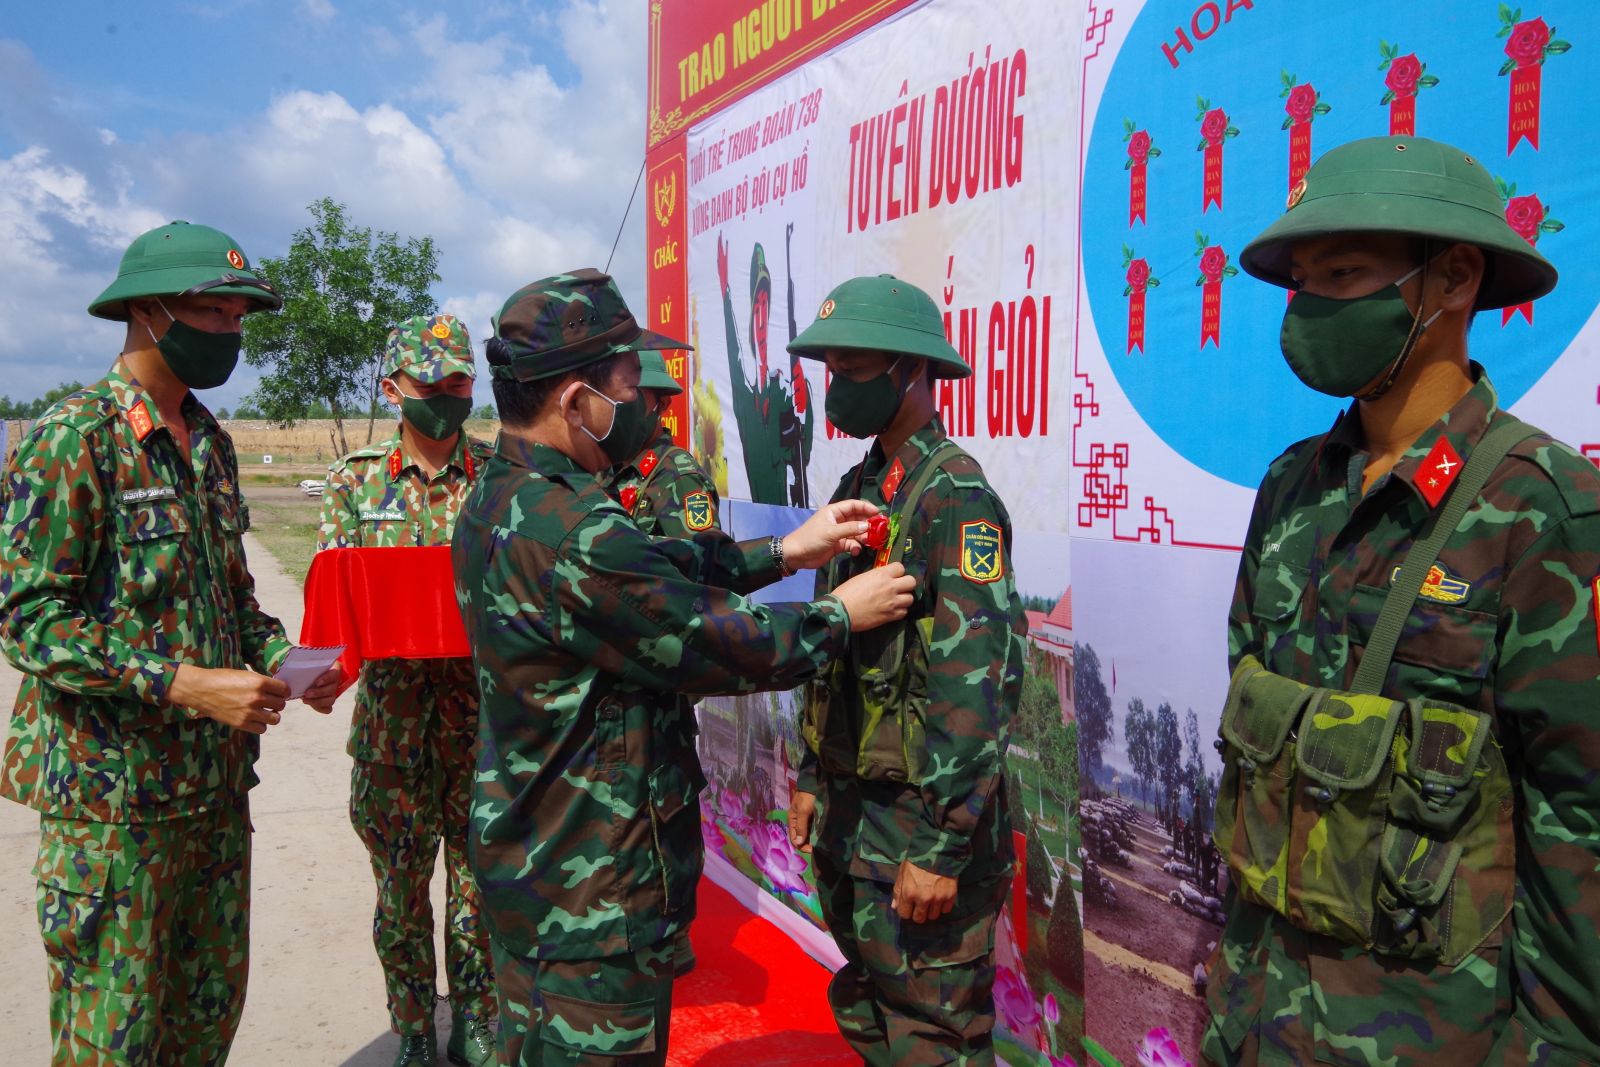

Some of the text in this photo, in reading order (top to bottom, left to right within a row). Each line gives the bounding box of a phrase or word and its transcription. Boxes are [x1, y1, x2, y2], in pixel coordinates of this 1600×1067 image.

[678, 32, 726, 102] TRAO
[1514, 81, 1536, 96] HOA
[690, 138, 706, 187] TUỔI
[708, 128, 725, 175] TRẺ
[727, 120, 760, 165] TRUNG
[797, 88, 823, 131] 738
[847, 44, 1027, 234] TUYÊN DƯƠNG
[711, 187, 733, 228] DANH
[735, 174, 748, 221] BỘ
[752, 165, 770, 214] ĐỘI
[773, 162, 788, 206] CỤ
[791, 139, 809, 193] HỒ
[654, 234, 678, 270] CHẮC
[661, 295, 673, 324] LÝ
[986, 243, 1052, 440] GIỎI
